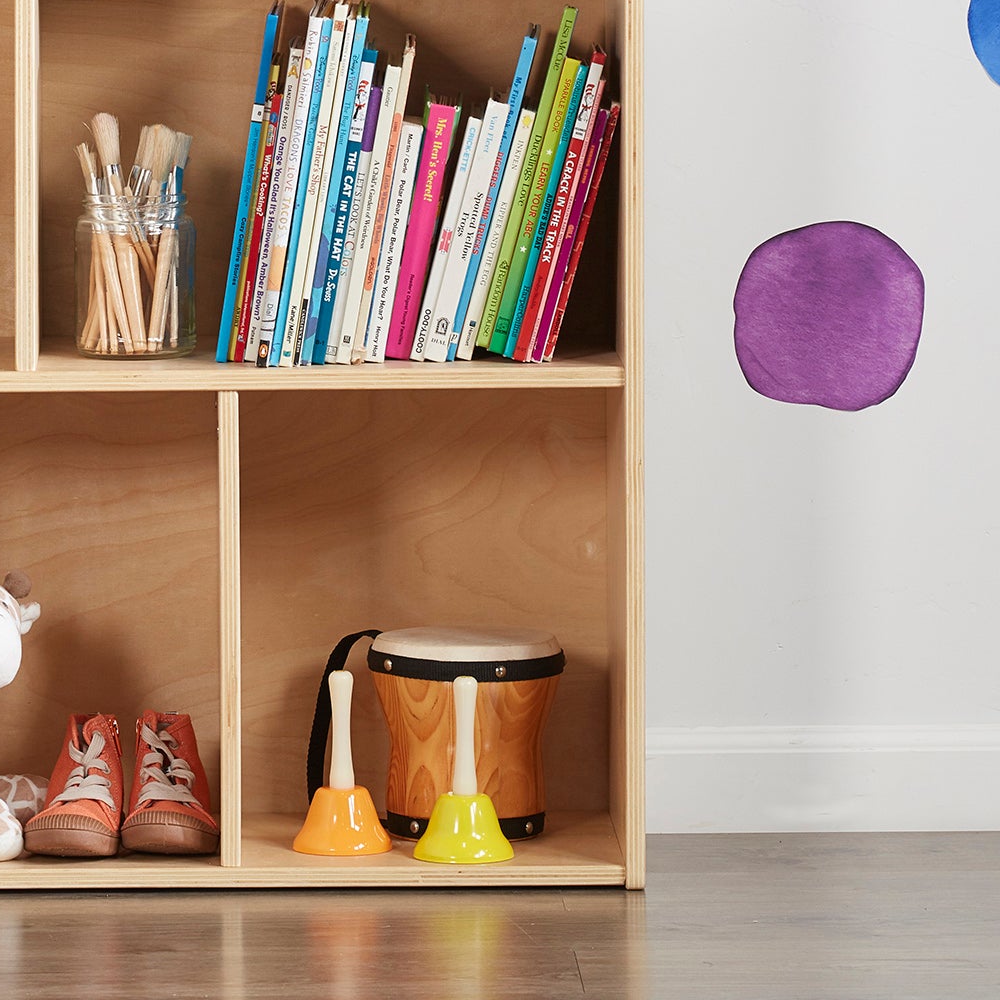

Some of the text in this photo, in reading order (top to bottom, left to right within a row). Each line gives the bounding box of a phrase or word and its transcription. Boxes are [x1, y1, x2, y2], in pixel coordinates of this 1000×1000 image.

[306, 30, 319, 55] Rubin
[554, 18, 573, 71] Lisa McCue
[313, 77, 322, 93] Pooh
[346, 54, 359, 91] Disney's Pooh
[513, 76, 523, 87] My
[284, 84, 292, 110] DANZIGER
[297, 72, 312, 108] Salmieri
[509, 89, 519, 107] First
[551, 77, 572, 132] SPARKLE BOOK
[317, 125, 328, 139] My
[483, 116, 498, 153] Van Fleet
[504, 109, 514, 128] Book
[338, 128, 346, 145] Hunt
[401, 133, 414, 173] Martin Carle
[261, 154, 271, 180] What's
[313, 140, 326, 174] Father's
[423, 119, 448, 202] Mrs. Hen's Secret!
[511, 139, 524, 170] INKPEN
[518, 134, 542, 207] Ducklings Love
[278, 119, 304, 232] DRAGONS LOVE TACOS
[308, 174, 319, 195] Shop
[370, 166, 380, 188] Child's
[254, 181, 268, 217] Cooking?
[330, 150, 357, 262] THE CAT IN THE HAT
[365, 211, 372, 219] of
[366, 189, 375, 210] Garden
[480, 196, 494, 221] DUMP
[522, 161, 550, 238] LEARN YOUR ABC
[540, 151, 576, 264] A CRACK IN THE TRACK
[253, 136, 287, 320] Orange You Glad It's Halloween, Amber Brown?
[340, 172, 366, 277] LET'S LOOK AT Colors
[360, 218, 371, 249] Weirdness
[457, 212, 470, 237] Frogs
[461, 192, 483, 259] Spotted Yellow
[472, 221, 487, 256] TRUCKS
[533, 193, 552, 250] ADDIE'S BAD DAY
[564, 224, 574, 239] GILL
[231, 217, 246, 285] Cozy Campfire Stories
[377, 179, 406, 321] Polar Bear, Polar Bear, What Do You Hear?
[479, 201, 507, 286] KIPPER AND THE EGG
[323, 268, 337, 303] Dr. Seuss
[407, 273, 416, 296] Reader's
[490, 269, 507, 308] Random
[265, 303, 273, 316] Dial
[287, 305, 297, 344] Kane/Miller
[400, 310, 408, 325] Young
[483, 308, 496, 337] House
[509, 284, 531, 338] HarperCollins
[373, 326, 381, 344] Henry
[397, 325, 405, 345] Families
